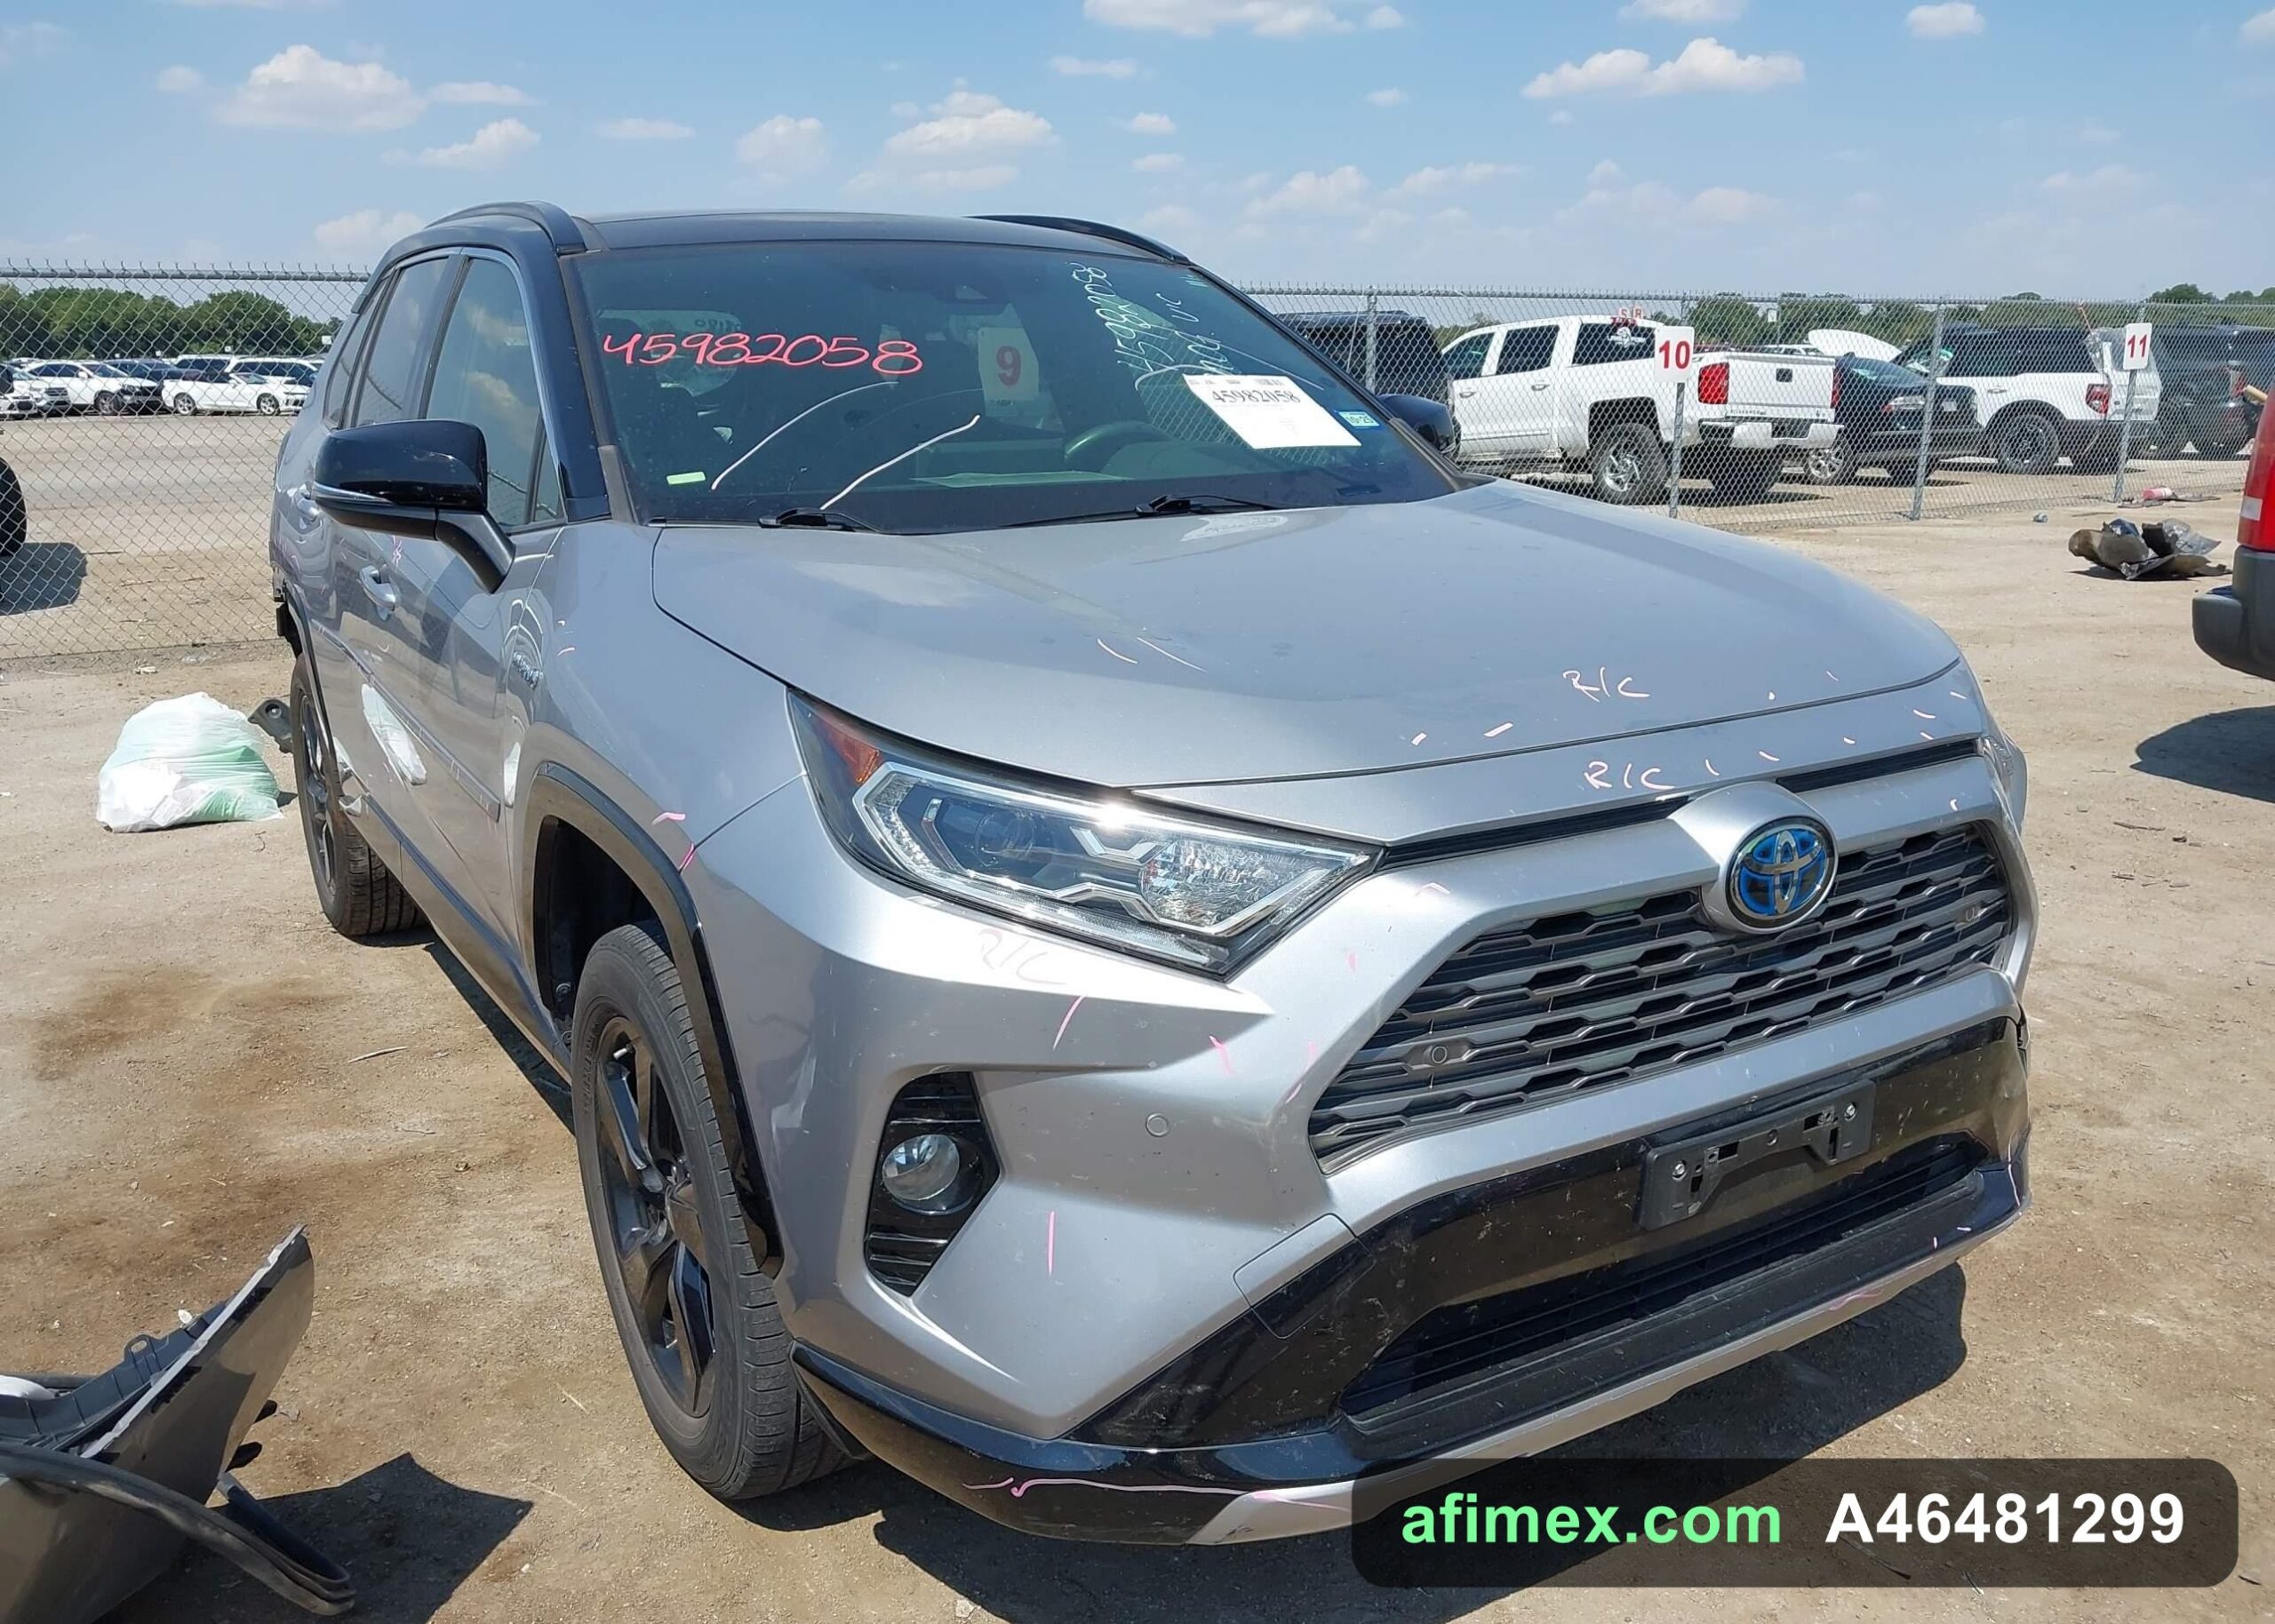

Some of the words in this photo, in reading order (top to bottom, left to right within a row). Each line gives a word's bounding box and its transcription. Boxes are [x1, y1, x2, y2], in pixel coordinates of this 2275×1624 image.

[603, 332, 924, 375] 45982058
[1658, 340, 1690, 370] 10
[2127, 334, 2148, 358] 11
[996, 346, 1021, 386] 9
[1212, 389, 1301, 404] 45982058
